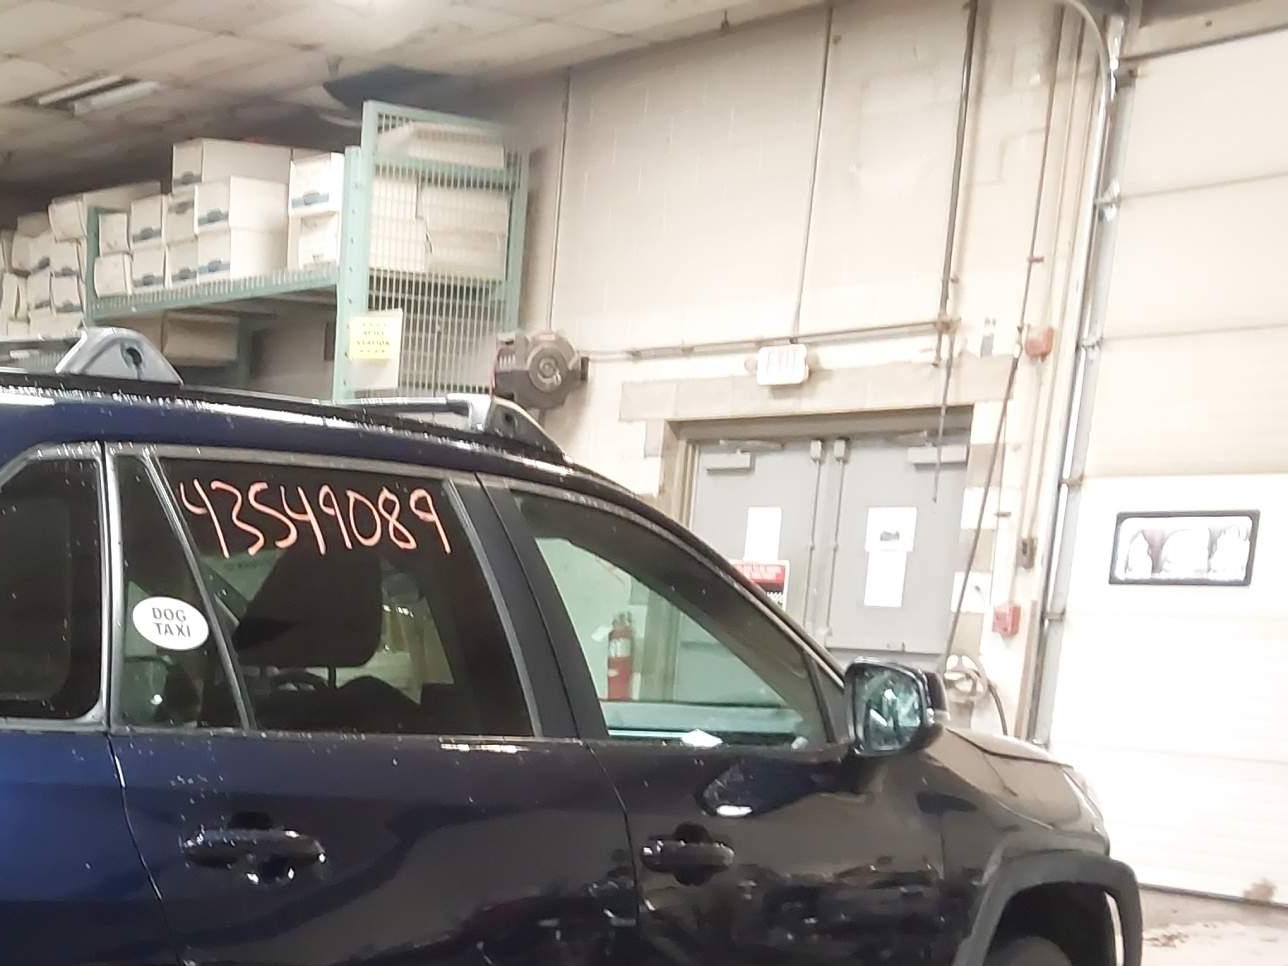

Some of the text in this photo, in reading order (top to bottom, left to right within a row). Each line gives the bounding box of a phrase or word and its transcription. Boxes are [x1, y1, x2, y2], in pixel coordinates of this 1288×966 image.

[179, 478, 453, 560] 43549089
[152, 607, 187, 622] DOG
[153, 622, 191, 638] TAXI
